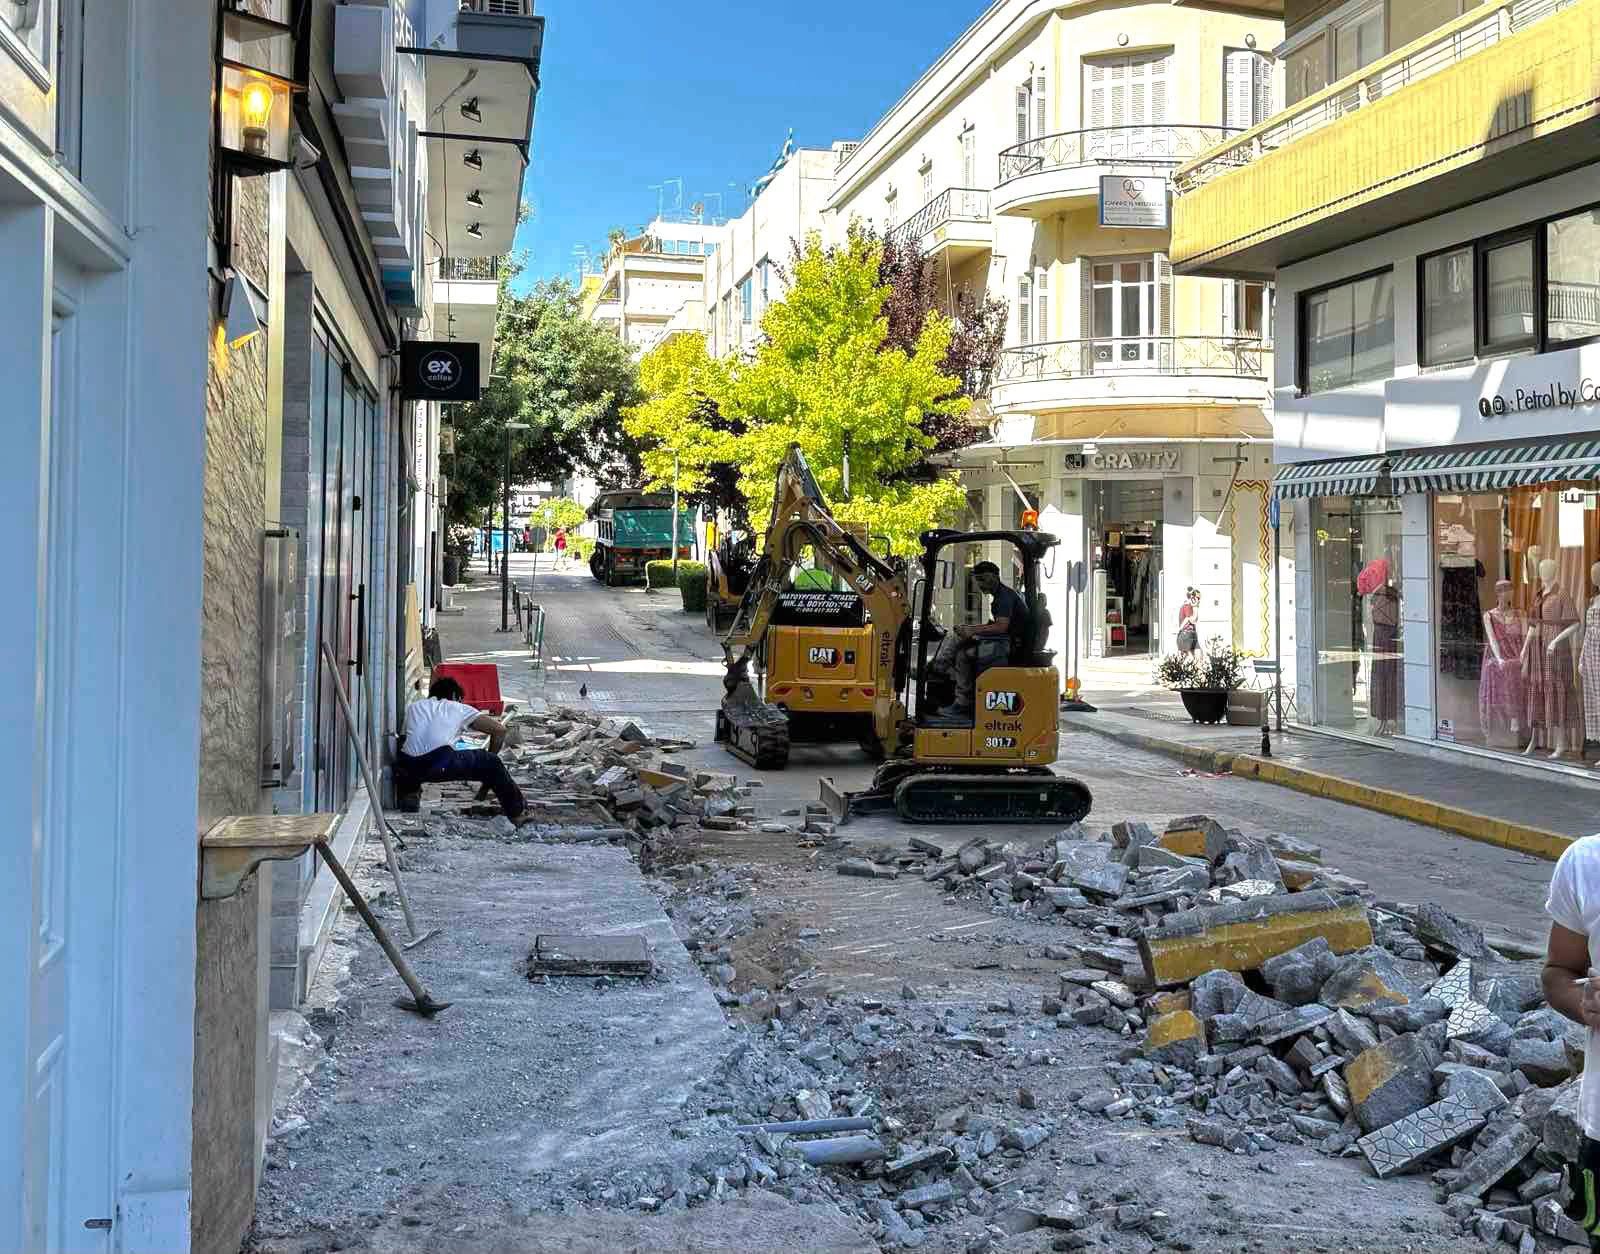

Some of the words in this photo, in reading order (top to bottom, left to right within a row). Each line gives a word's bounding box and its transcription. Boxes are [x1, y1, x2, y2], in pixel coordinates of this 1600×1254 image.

[427, 360, 452, 374] ex
[1515, 383, 1556, 411] Petrol
[1557, 381, 1577, 410] by
[809, 647, 835, 664] CAT
[880, 631, 893, 667] eltrak
[985, 691, 1016, 711] CAT
[984, 719, 1023, 732] eltrak
[985, 736, 1012, 748] 301.7
